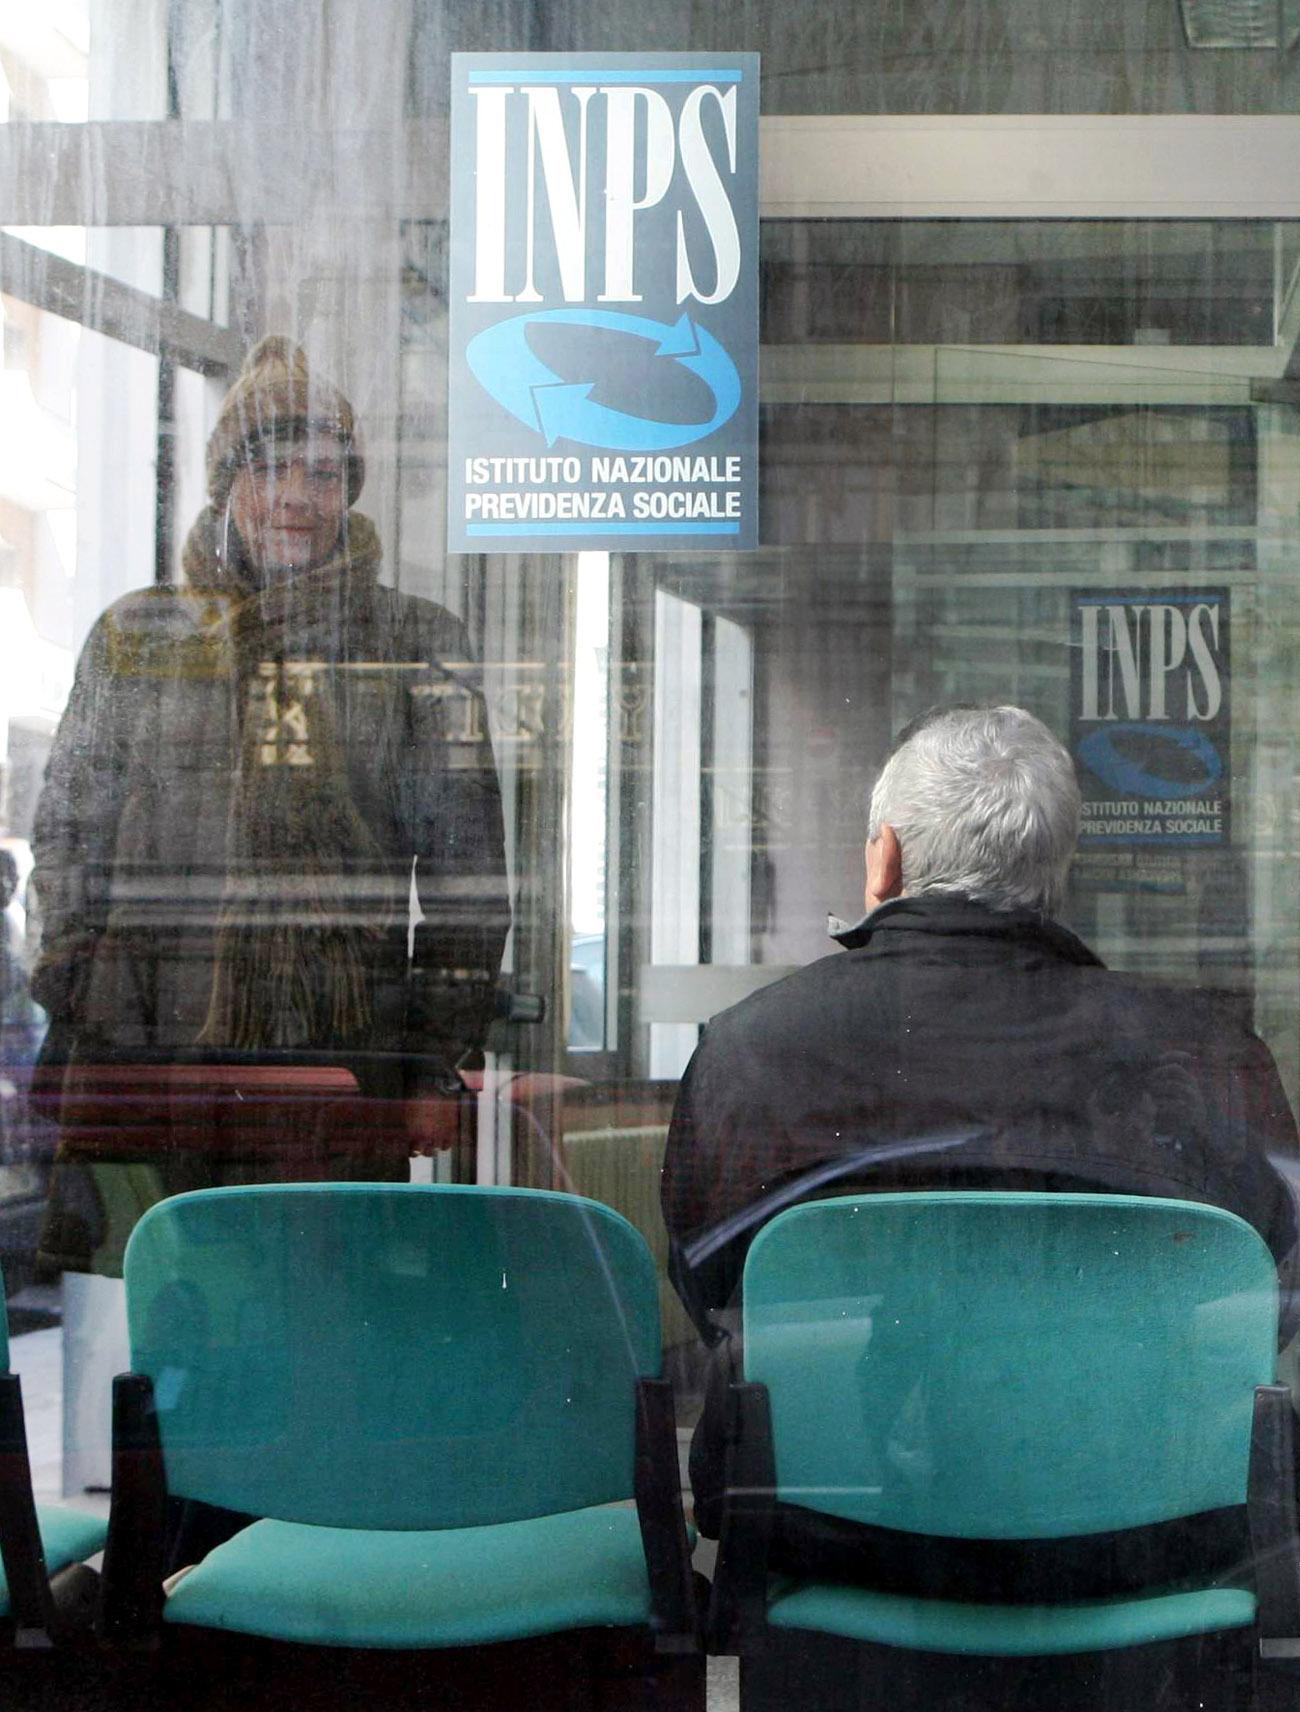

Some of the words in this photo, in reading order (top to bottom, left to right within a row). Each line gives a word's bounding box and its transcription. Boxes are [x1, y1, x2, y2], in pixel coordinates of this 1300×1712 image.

[466, 84, 741, 305] INPS
[465, 457, 581, 484] ISTITUTO
[591, 456, 741, 483] NAZIONALE
[465, 492, 626, 519] PREVIDENZA
[633, 491, 741, 518] SOCIALE
[1078, 603, 1222, 721] INPS
[1081, 801, 1139, 816] STITUTO
[1143, 801, 1222, 815] NAZIONALE
[1079, 820, 1162, 834] PREVIDENZA
[1165, 819, 1223, 833] SOCIALE
